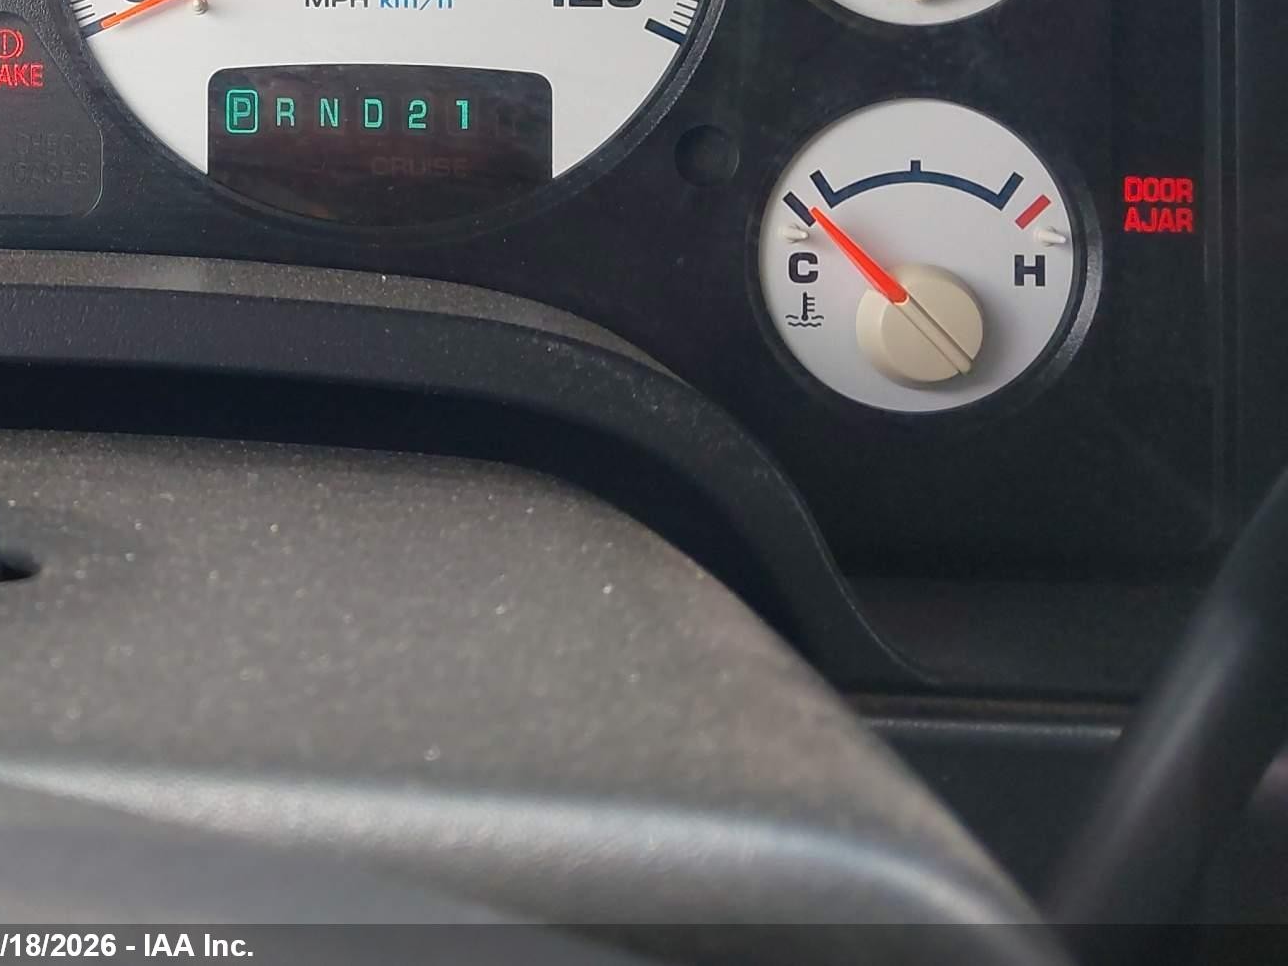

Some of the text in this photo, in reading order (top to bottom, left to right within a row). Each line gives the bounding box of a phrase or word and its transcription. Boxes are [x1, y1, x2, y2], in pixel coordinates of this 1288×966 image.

[232, 97, 469, 130] P R N D 2 1
[1124, 177, 1194, 202] DOOR
[1124, 207, 1194, 232] AJAR
[788, 251, 819, 284] C
[1014, 254, 1046, 288] H
